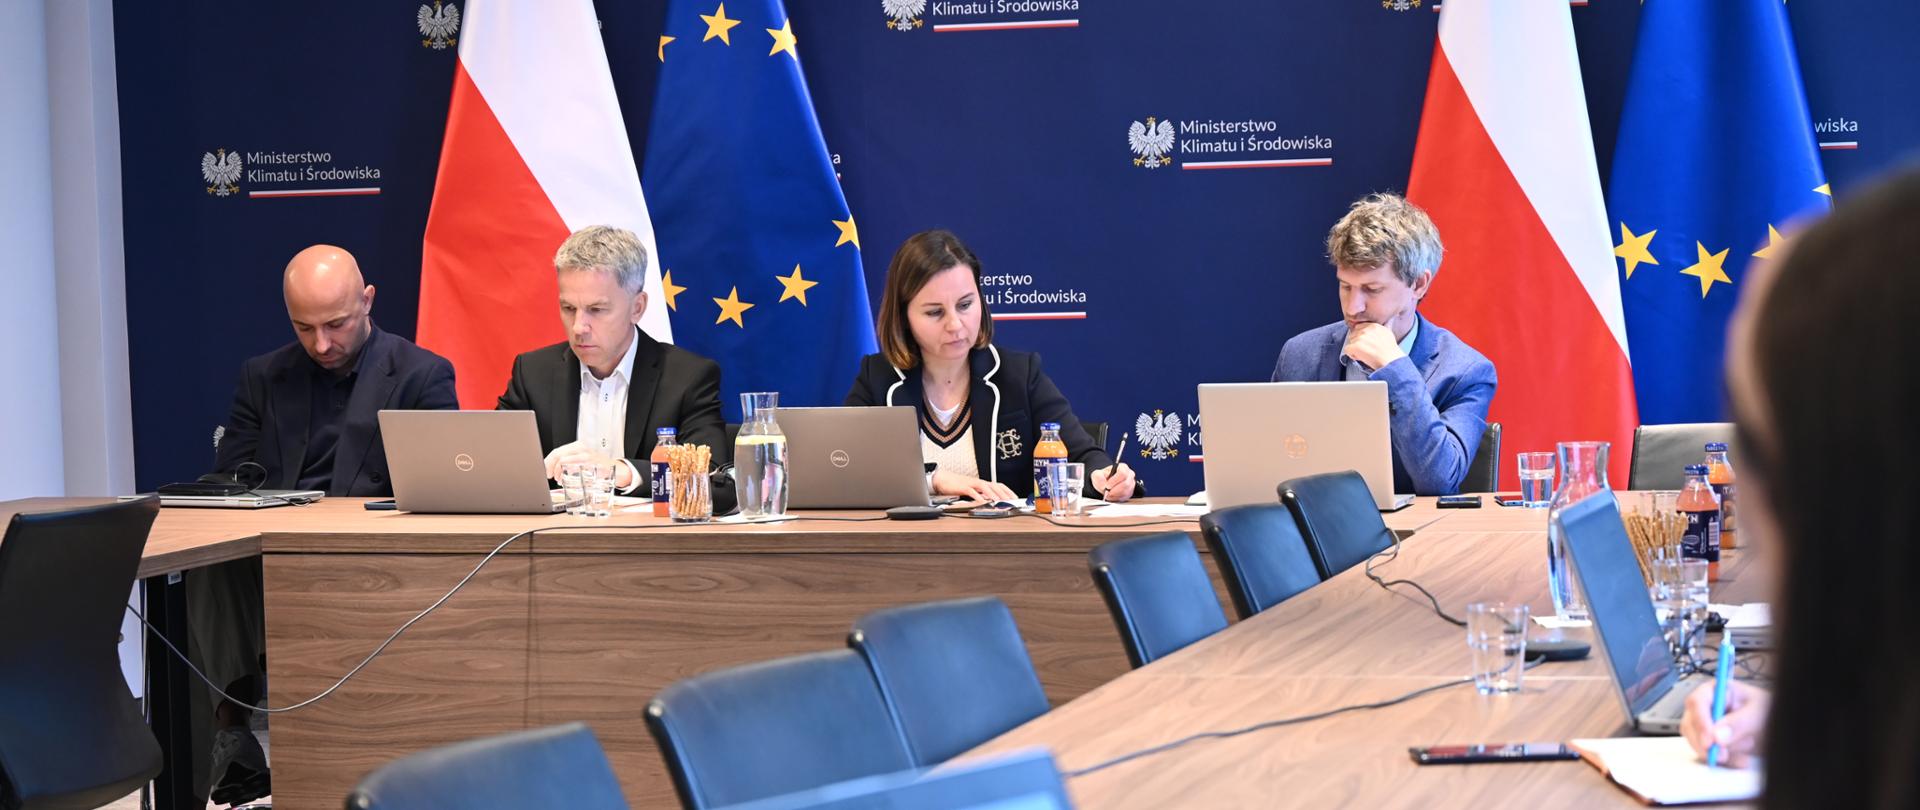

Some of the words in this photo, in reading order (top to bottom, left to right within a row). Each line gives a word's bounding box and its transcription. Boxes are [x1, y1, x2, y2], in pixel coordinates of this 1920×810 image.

[932, 0, 987, 16] Klimatu
[990, 0, 994, 14] i
[1180, 119, 1277, 134] Ministerstwo
[1814, 117, 1858, 133] wiska
[1180, 138, 1237, 153] Klimatu
[1240, 138, 1245, 152] i
[1247, 135, 1332, 151] Środowiska
[247, 151, 332, 165] Ministerstwo
[247, 168, 298, 183] Klimatu
[300, 168, 304, 181] i
[306, 165, 381, 181] Środowiska
[997, 291, 1002, 304] i
[1004, 288, 1087, 304] Środowiska
